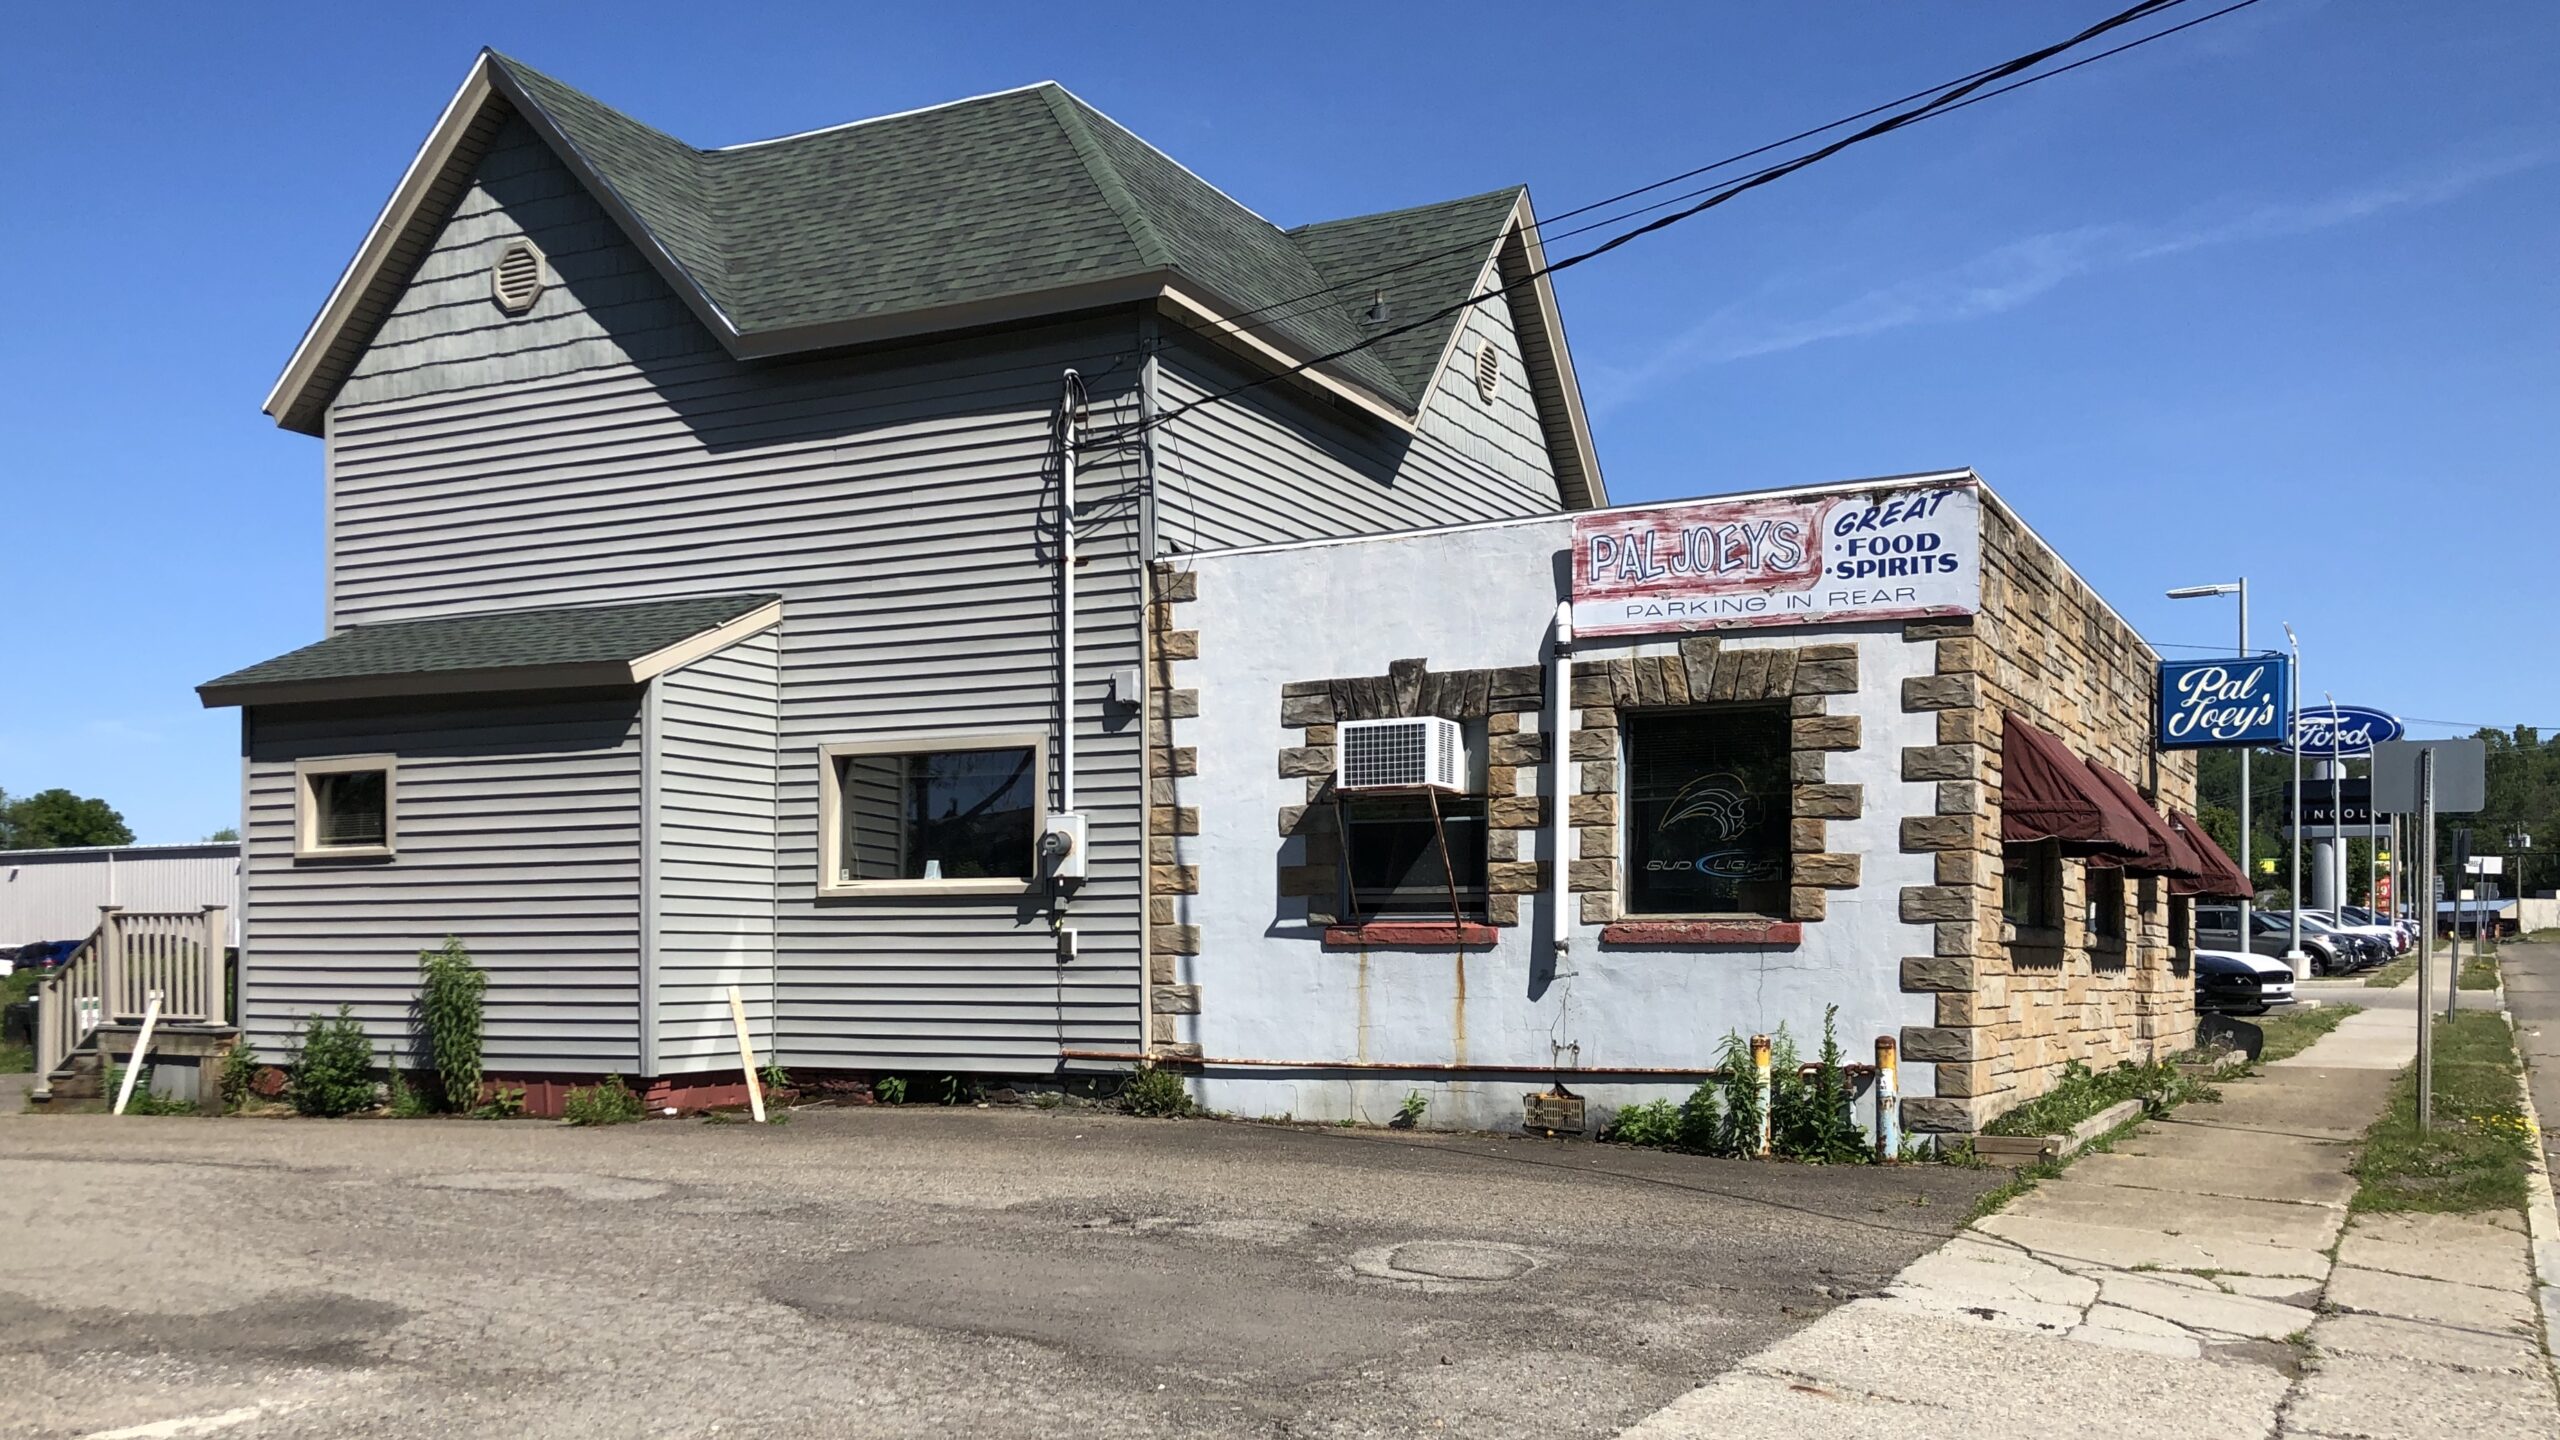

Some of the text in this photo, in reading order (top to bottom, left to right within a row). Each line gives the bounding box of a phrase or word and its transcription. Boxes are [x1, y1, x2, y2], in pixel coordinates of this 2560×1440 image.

[1834, 490, 1954, 537] GREAT
[1590, 520, 1801, 582] PAL JOEYS
[1848, 533, 1941, 557] FOOD
[1836, 553, 1959, 580] SPIRITS
[1626, 587, 1916, 619] PARKING IN REAR
[2177, 666, 2264, 708] Pal
[2168, 693, 2275, 739] Joey's
[2288, 716, 2371, 747] Ford
[1646, 859, 1693, 871] BUD
